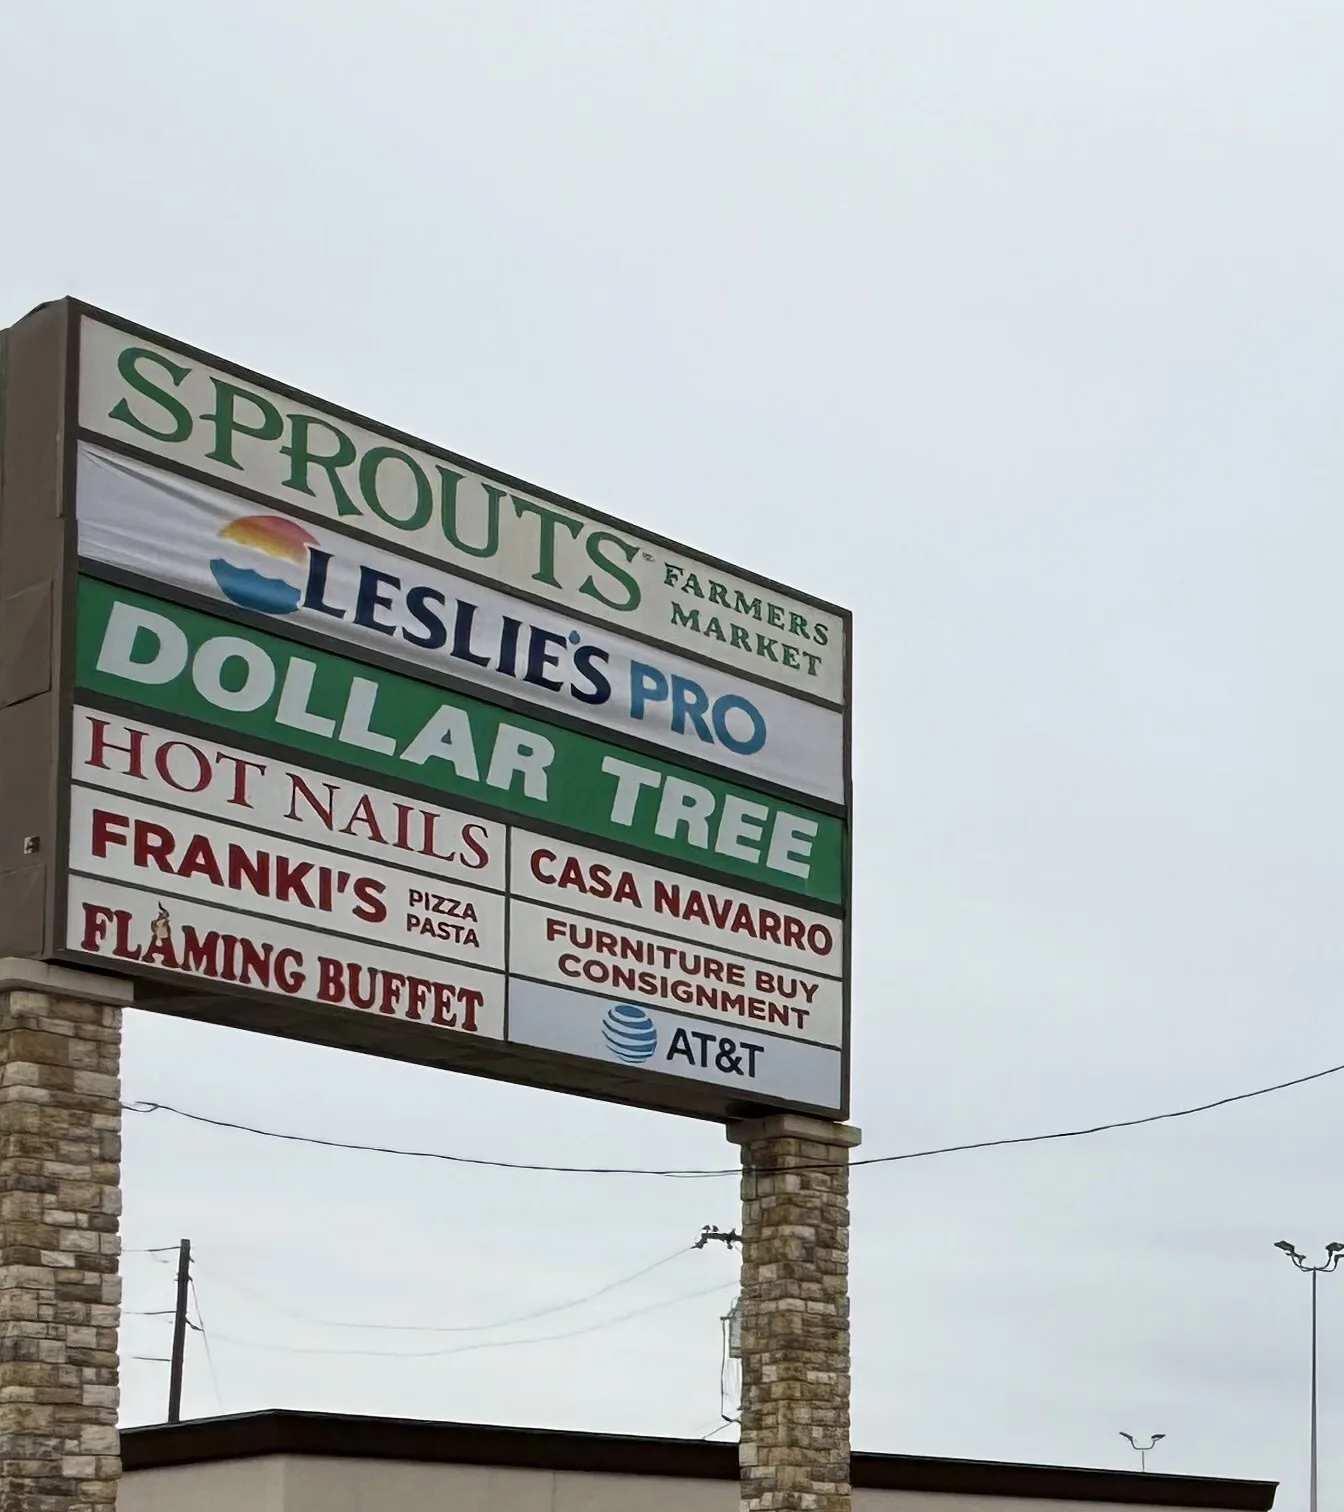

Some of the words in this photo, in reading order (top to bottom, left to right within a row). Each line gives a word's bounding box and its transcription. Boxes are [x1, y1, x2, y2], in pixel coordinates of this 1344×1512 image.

[107, 346, 641, 612] SPROUTS
[302, 546, 612, 705] LESLIE'S
[630, 659, 767, 755] PRO
[663, 562, 829, 646] FARMERS
[670, 600, 822, 677] MARKET
[95, 600, 556, 802] DOLLAR
[601, 755, 819, 880] TREE
[84, 715, 267, 809] HOT
[283, 772, 490, 870] NAILS
[91, 808, 388, 924] FRANKI'S
[408, 888, 479, 923] PIZZA
[529, 848, 643, 909] CASA
[653, 880, 834, 956] NAVARRO
[80, 901, 307, 994] FLAMING
[317, 956, 485, 1033] BUFFET
[406, 912, 481, 949] PASTA
[545, 917, 746, 988] FURNITURE
[755, 970, 820, 1004] BUY
[557, 953, 811, 1030] CONSIGNMENT
[665, 1026, 765, 1079] AT&T
